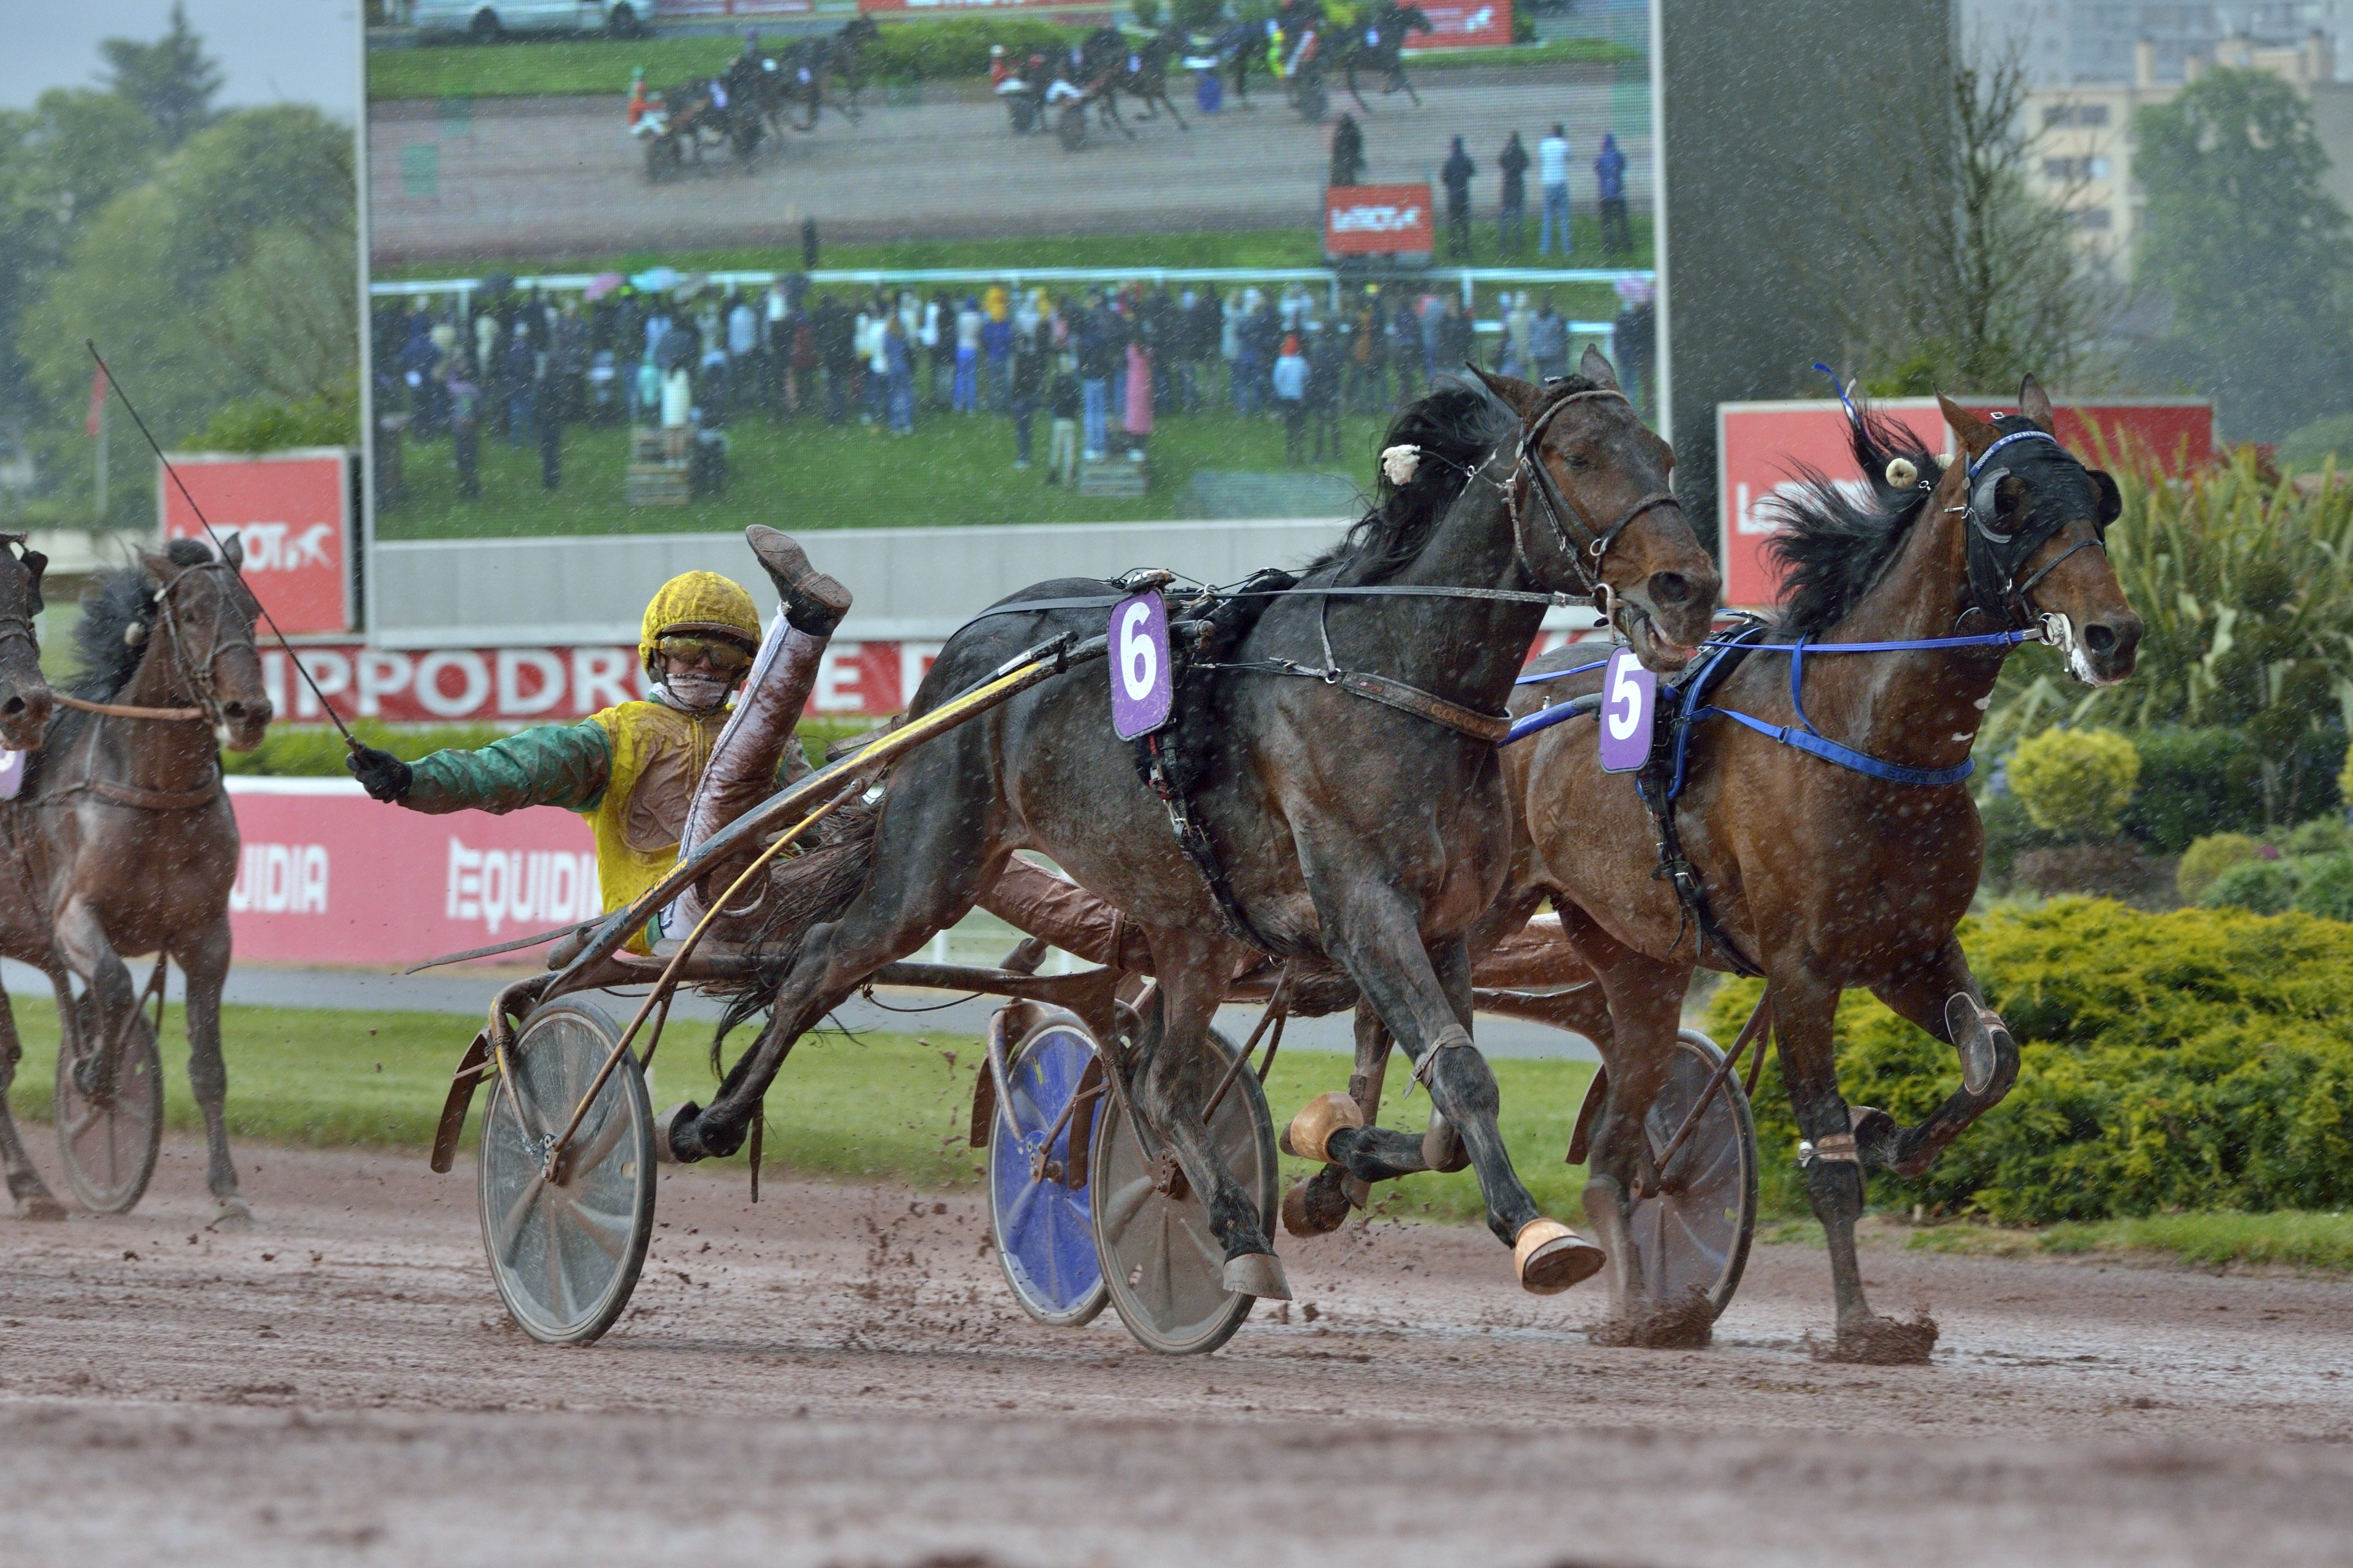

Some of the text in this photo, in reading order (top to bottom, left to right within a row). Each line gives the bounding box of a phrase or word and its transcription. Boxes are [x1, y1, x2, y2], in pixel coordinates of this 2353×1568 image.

[1120, 602, 1156, 700] 6
[1609, 654, 1644, 740] 5
[229, 843, 328, 912] UIDIA
